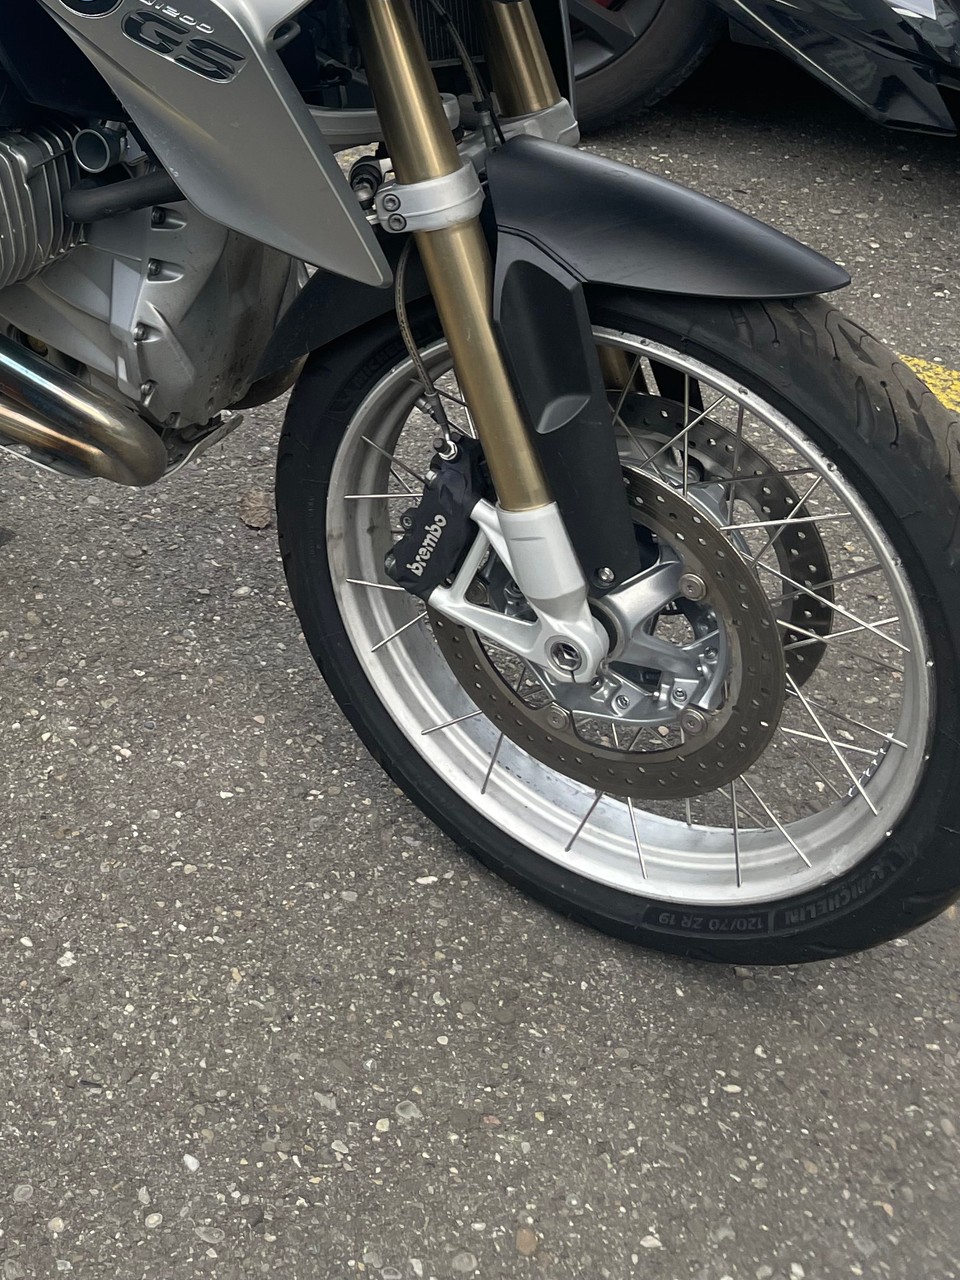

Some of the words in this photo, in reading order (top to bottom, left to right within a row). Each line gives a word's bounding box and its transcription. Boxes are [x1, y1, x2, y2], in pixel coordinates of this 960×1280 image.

[121, 10, 248, 84] GS
[406, 514, 447, 577] brembo
[657, 911, 678, 926] 19
[680, 914, 704, 929] ZR
[785, 875, 874, 926] MICHELIN
